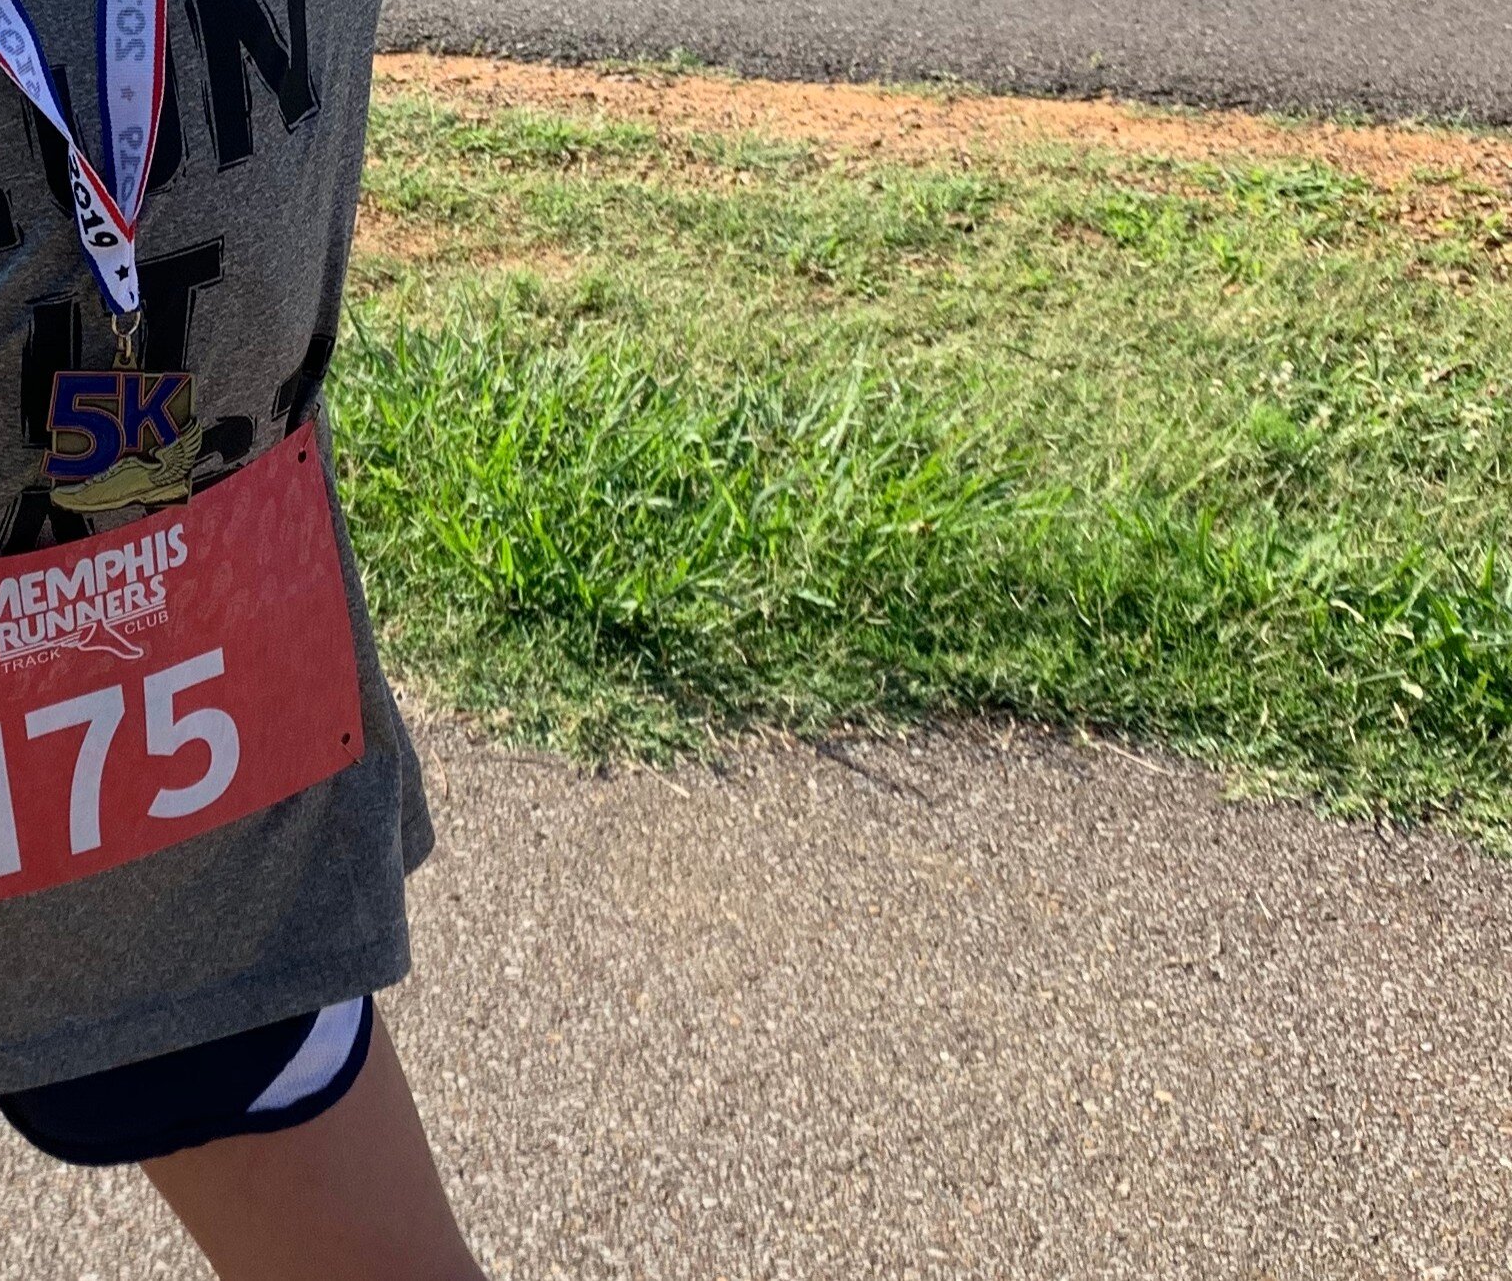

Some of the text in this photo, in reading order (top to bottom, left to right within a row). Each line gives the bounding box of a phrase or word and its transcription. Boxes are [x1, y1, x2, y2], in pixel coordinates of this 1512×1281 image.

[67, 153, 120, 248] 2019
[40, 371, 193, 481] 5K
[0, 610, 169, 674] TRACK CLUB
